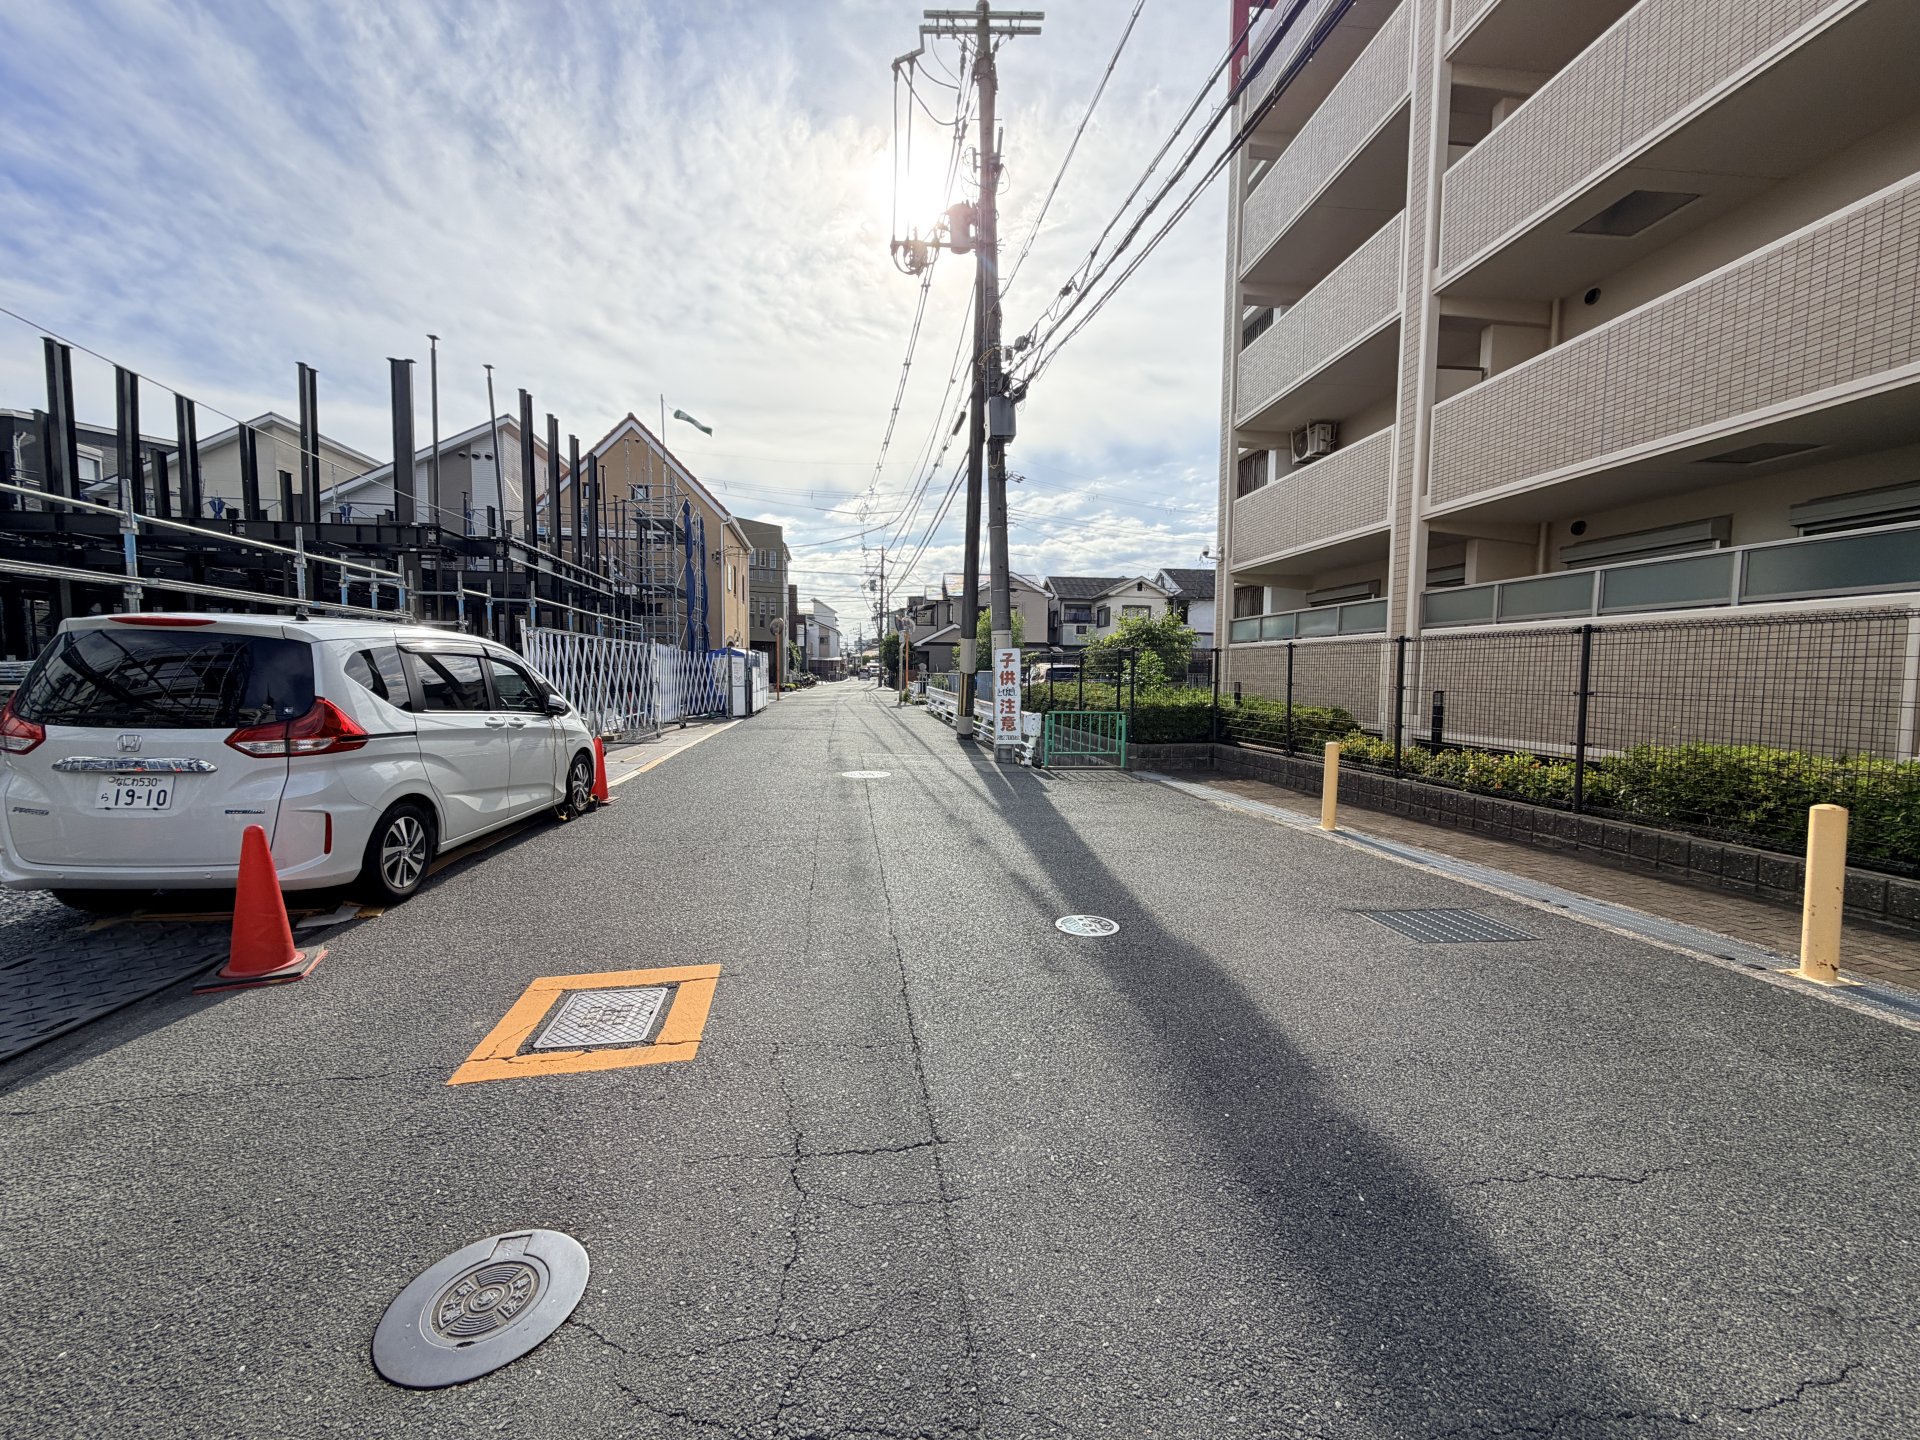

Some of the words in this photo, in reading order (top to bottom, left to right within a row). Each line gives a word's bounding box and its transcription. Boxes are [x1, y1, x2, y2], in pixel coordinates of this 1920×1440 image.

[999, 653, 1016, 686] 子供
[1000, 698, 1016, 732] 注意
[114, 789, 168, 806] 19-10
